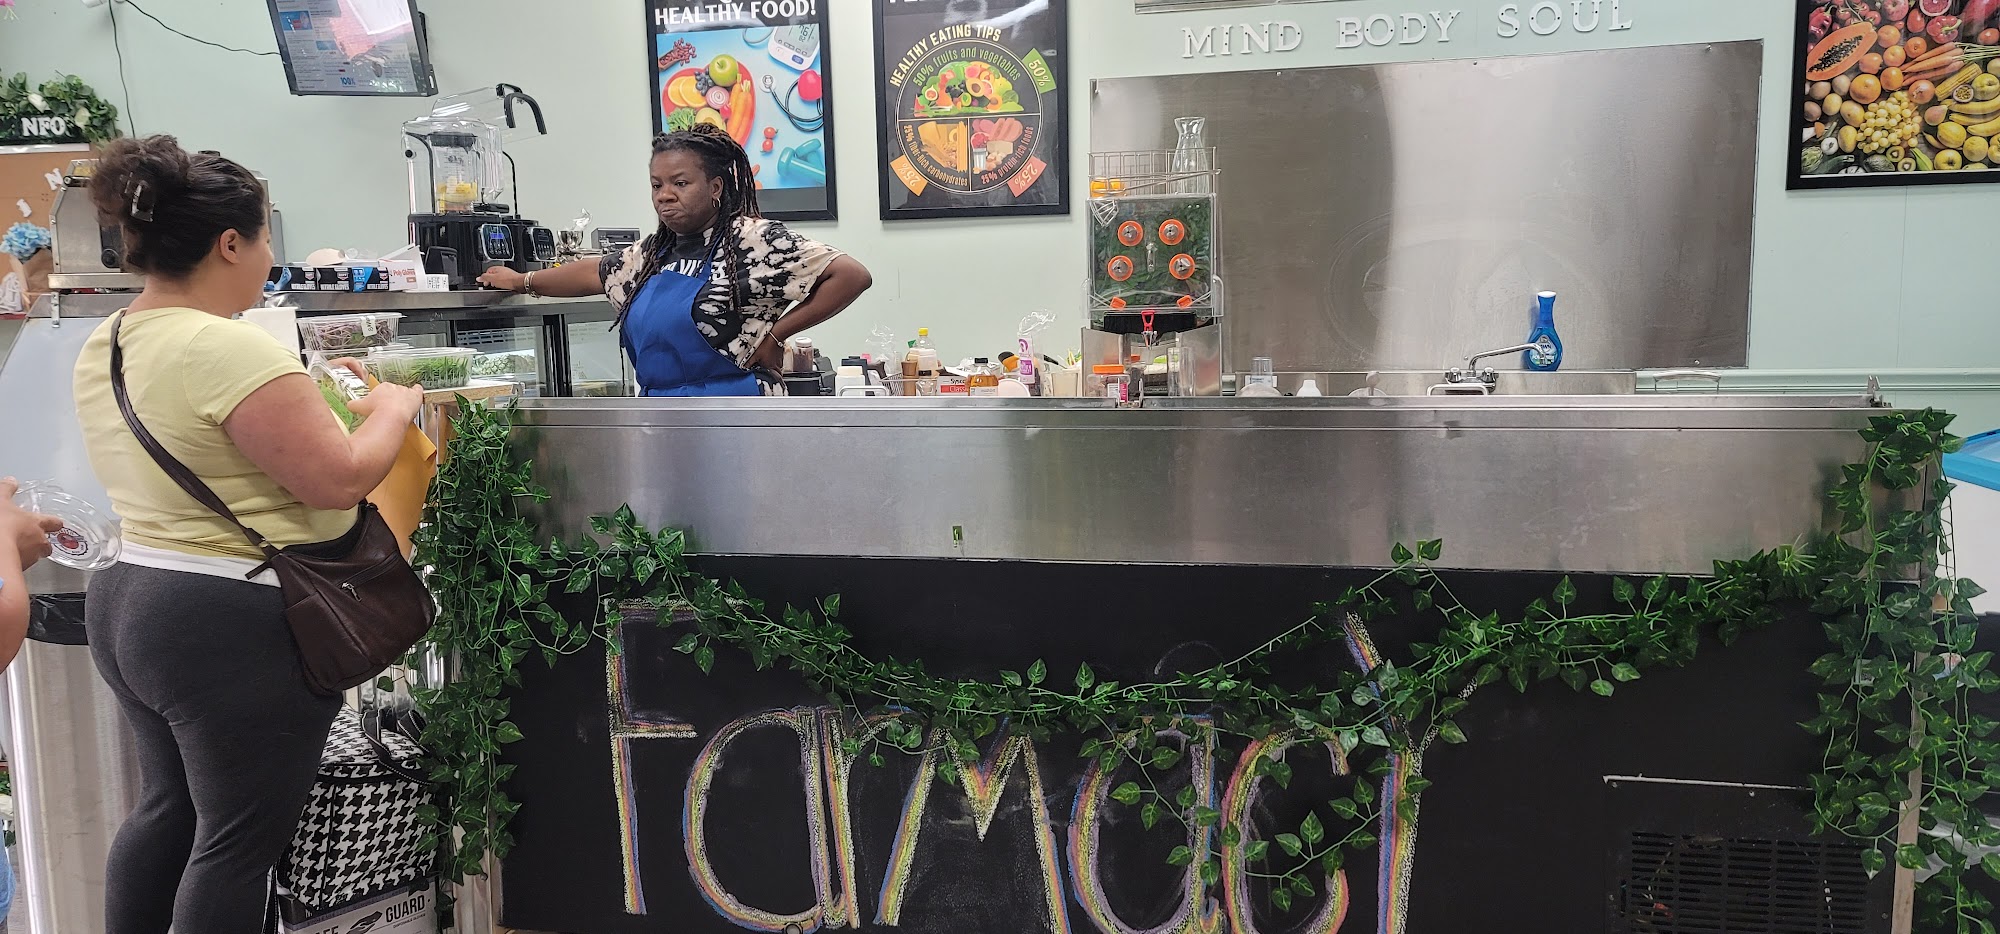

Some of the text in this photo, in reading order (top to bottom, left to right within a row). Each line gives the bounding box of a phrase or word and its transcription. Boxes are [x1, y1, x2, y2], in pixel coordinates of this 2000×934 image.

[654, 0, 817, 25] HEALTHY FOOD!
[1181, 0, 1633, 58] MIND BODY SOUL
[889, 24, 1002, 87] HEALTHY EATING TIPS
[912, 46, 1021, 87] 50% fruits and vegetables
[1028, 59, 1051, 87] 50%
[21, 116, 66, 137] NFO
[903, 124, 915, 142] 25%
[927, 165, 968, 187] carbohydrates
[981, 126, 1034, 184] 25% protein-rich foods
[897, 163, 921, 187] 25%
[1014, 163, 1038, 189] 25%
[385, 895, 425, 923] GUARD
